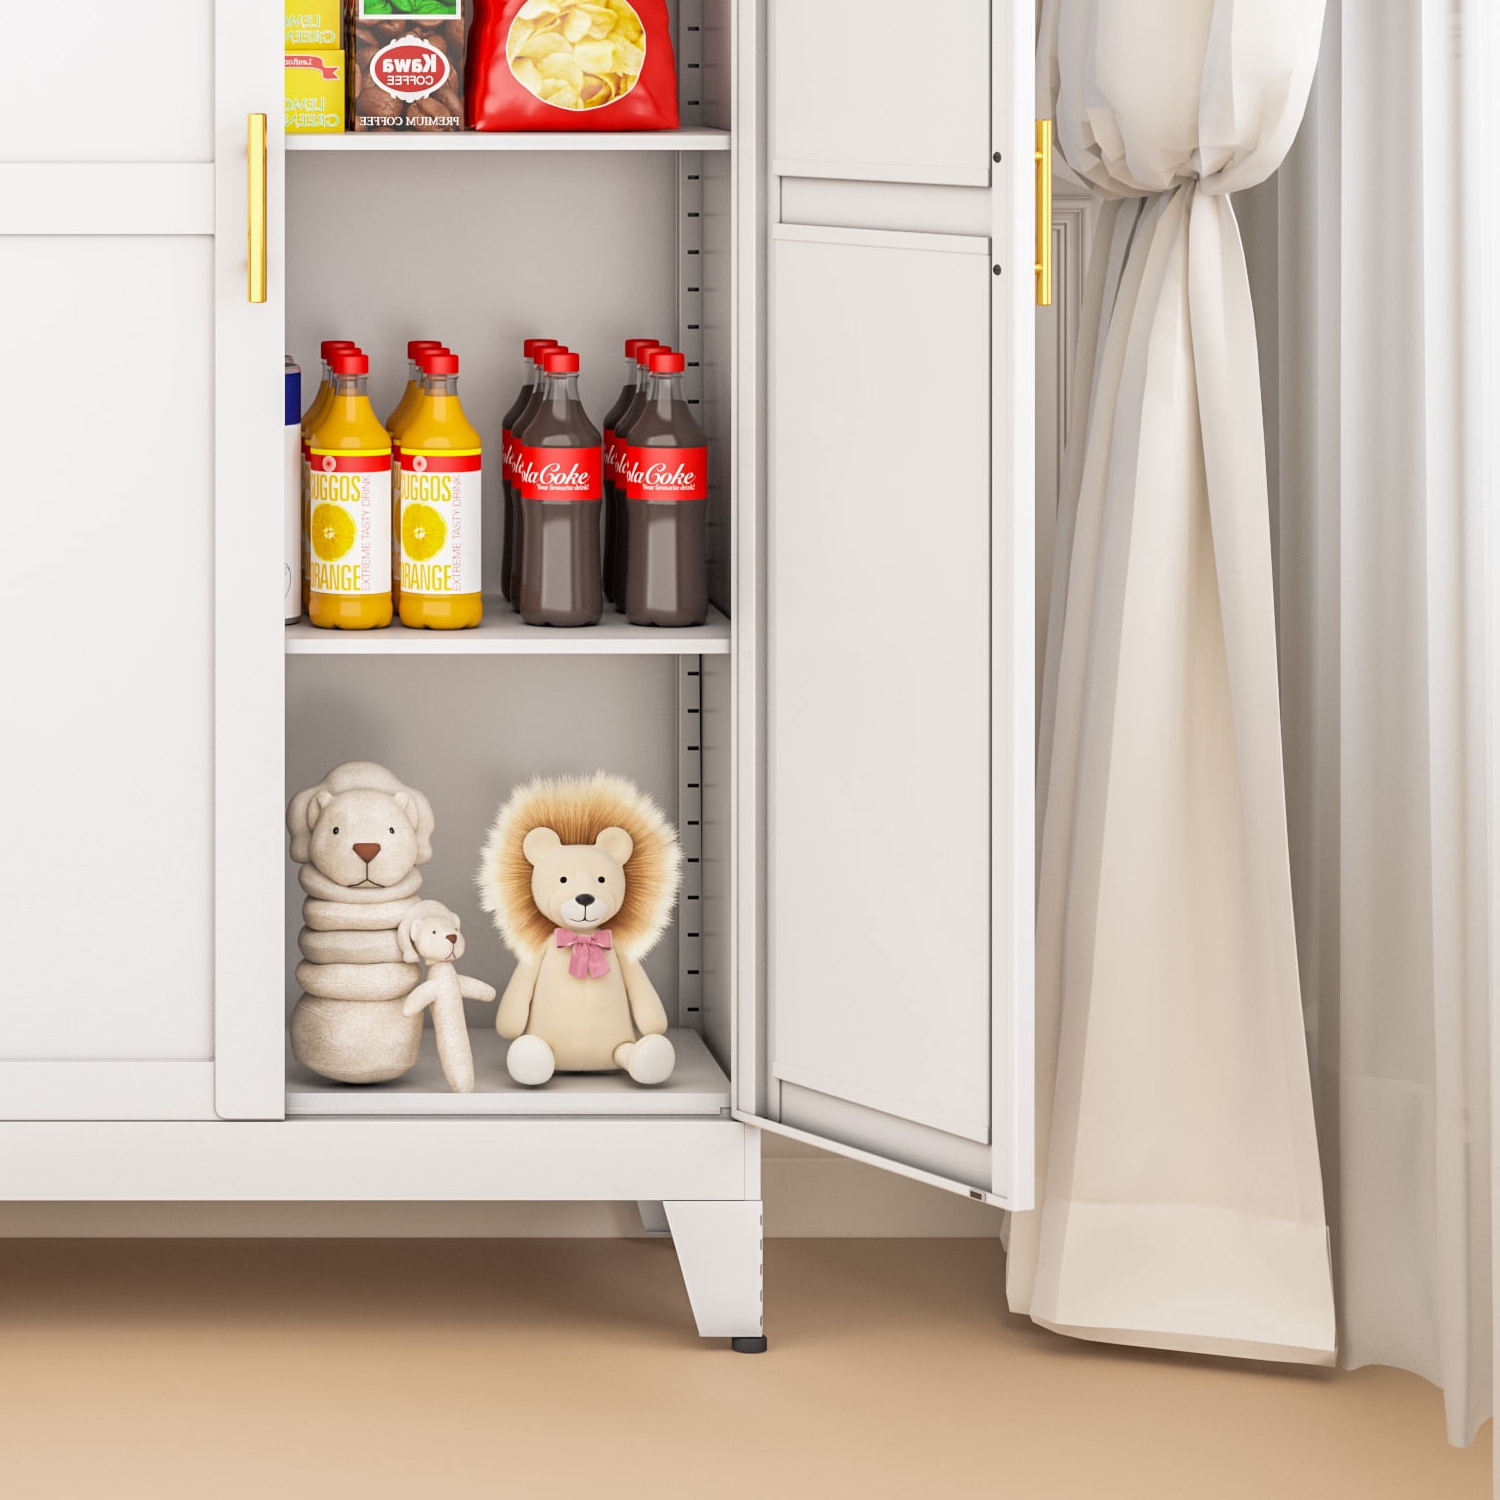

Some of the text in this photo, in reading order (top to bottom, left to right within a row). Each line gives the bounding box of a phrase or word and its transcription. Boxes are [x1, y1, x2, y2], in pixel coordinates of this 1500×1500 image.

[540, 462, 590, 485] Coke
[645, 462, 696, 485] Coke
[361, 475, 371, 591] EXTREME TASTY DRINK
[452, 475, 461, 591] EXTREME TASTY DRINK
